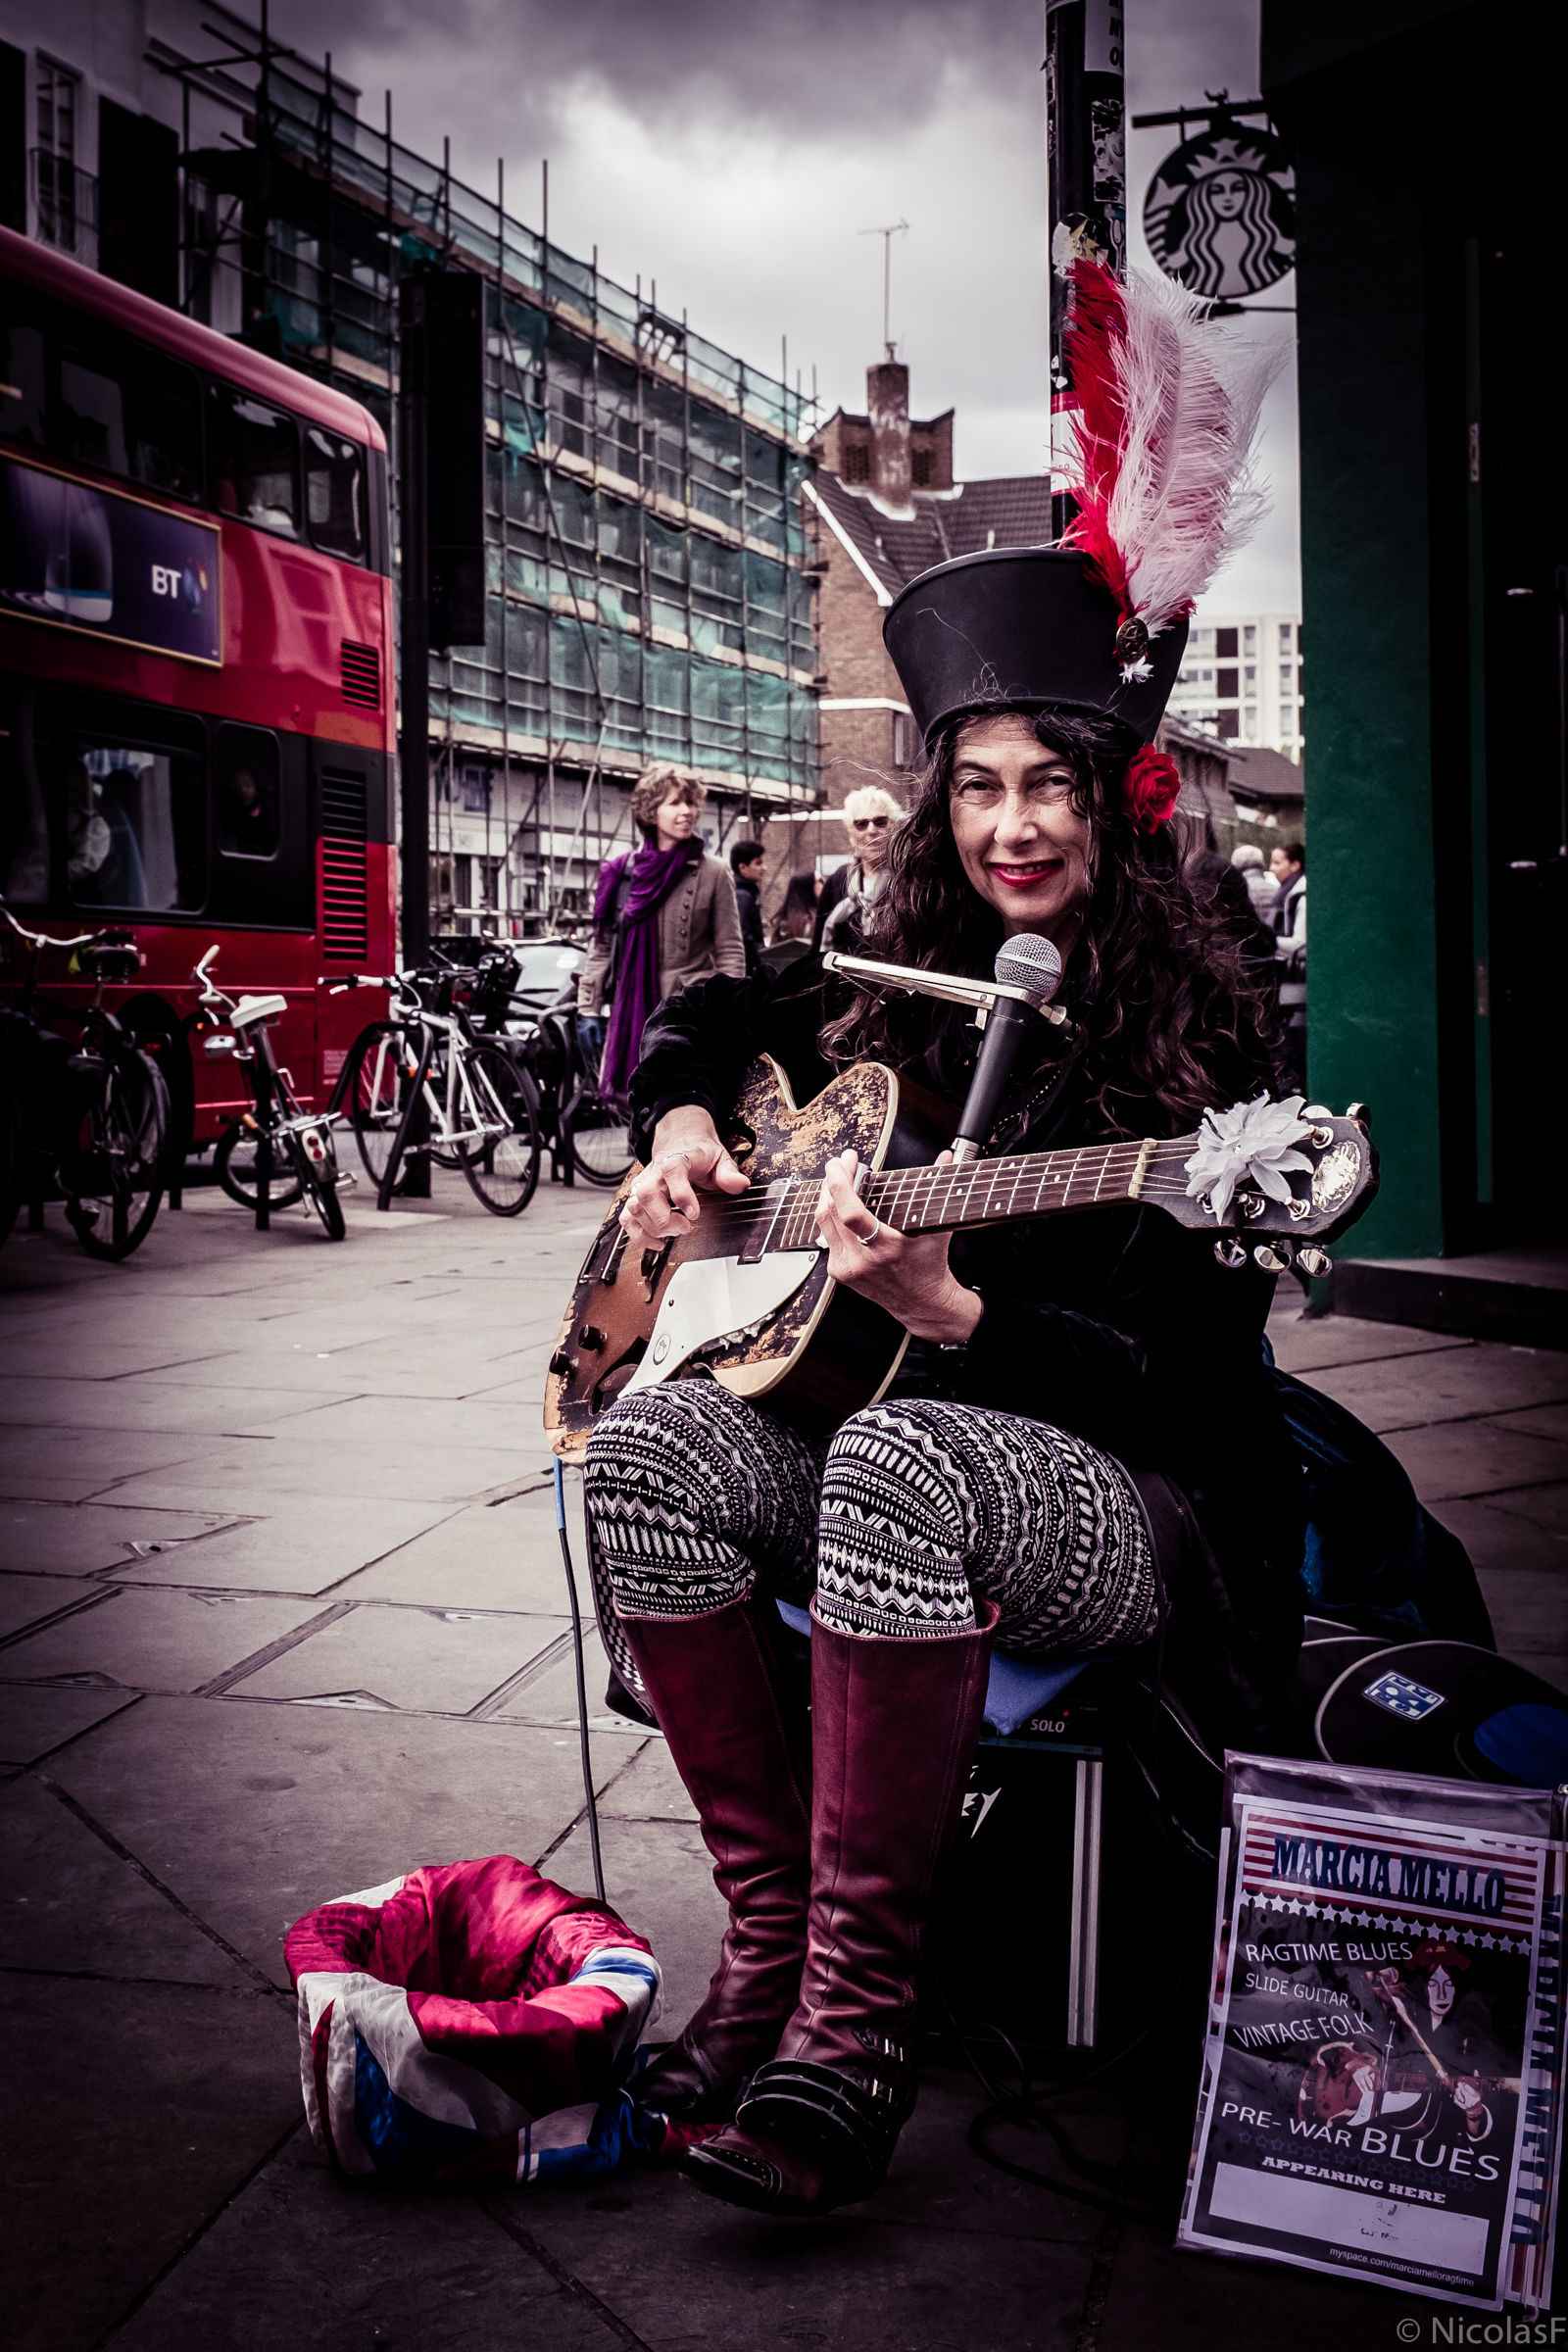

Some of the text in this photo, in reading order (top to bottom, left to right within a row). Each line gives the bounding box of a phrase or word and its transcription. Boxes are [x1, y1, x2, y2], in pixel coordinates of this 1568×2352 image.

[152, 564, 182, 599] BT
[1030, 1719, 1066, 1734] SOLO
[1272, 1832, 1506, 1919] MARCIA MELLO
[1245, 1942, 1413, 1962] RAGTIME BLUES
[1245, 1972, 1349, 2009] SLIDE GUITAR
[1233, 2011, 1374, 2049] VINTAGE FOLK
[1221, 2102, 1501, 2181] PRE- WAR BLUES
[1261, 2156, 1446, 2204] APPEARING HERE
[1329, 2246, 1475, 2287] myspace.com/marciamelloragtime
